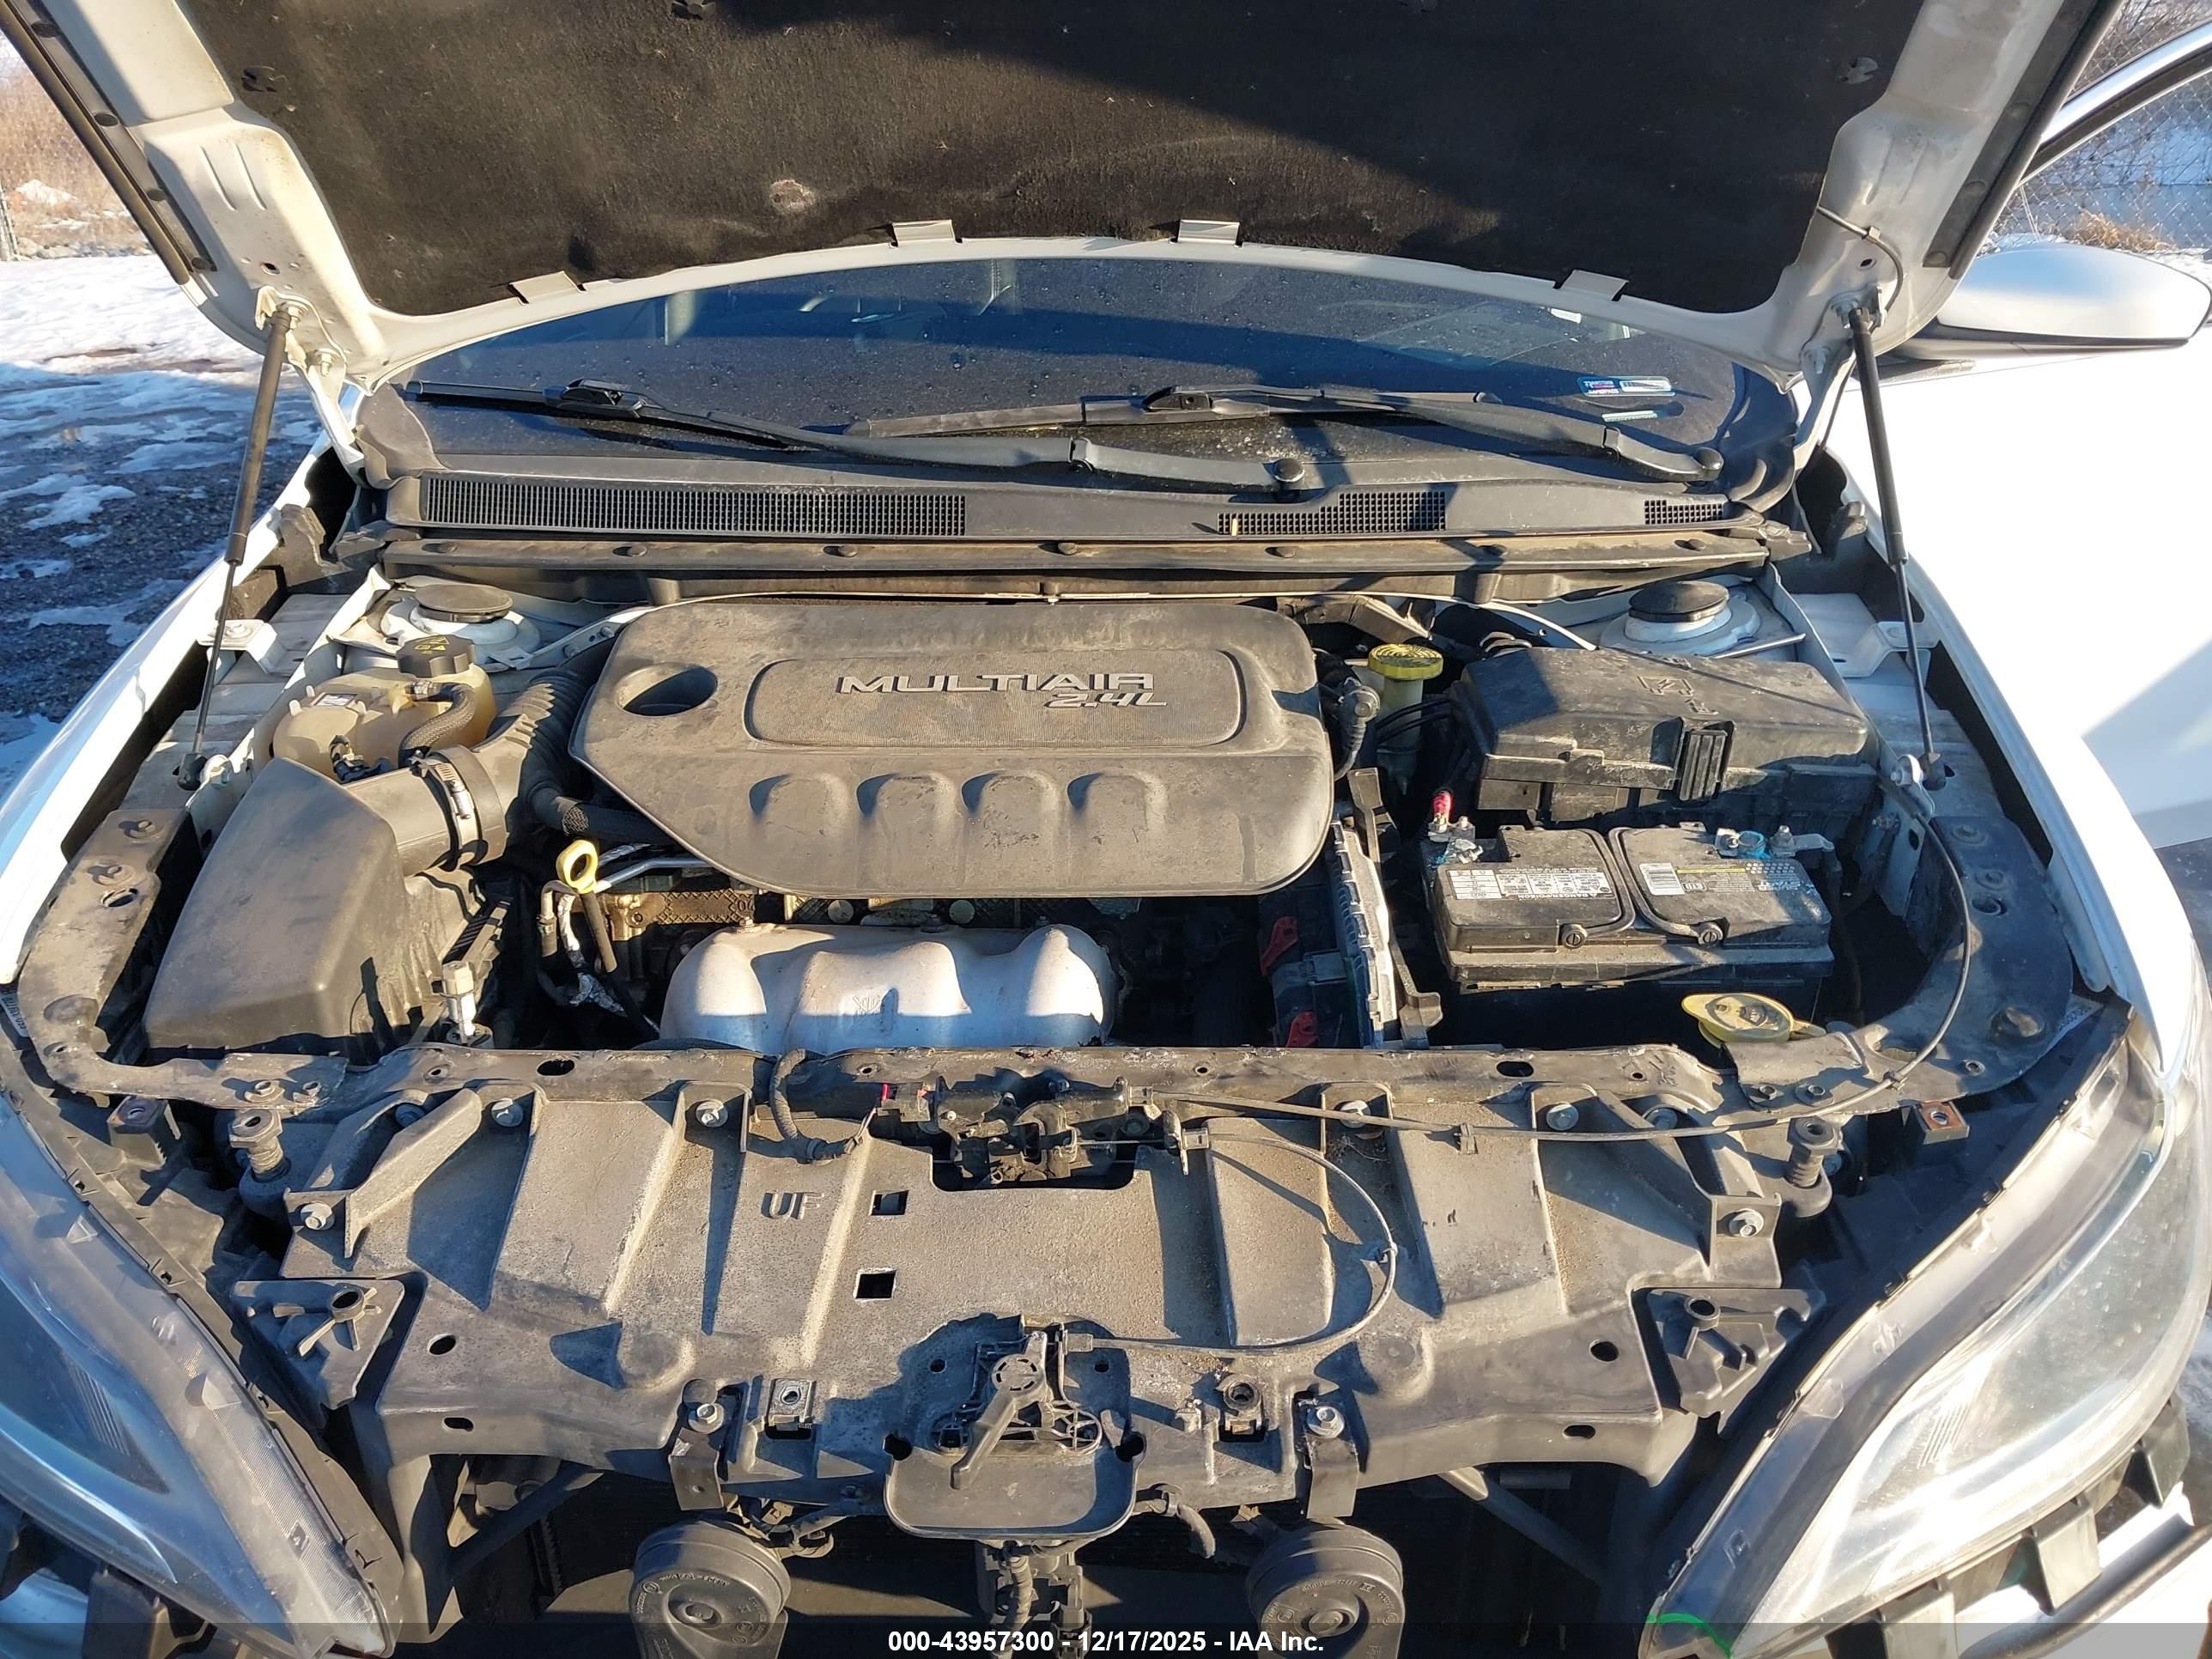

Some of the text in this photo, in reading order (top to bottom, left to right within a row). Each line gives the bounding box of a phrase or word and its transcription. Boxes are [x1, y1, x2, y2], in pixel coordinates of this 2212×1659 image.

[837, 673, 1154, 694] MULTIAIR
[1044, 692, 1167, 708] 2.4L
[761, 1190, 824, 1220] UF
